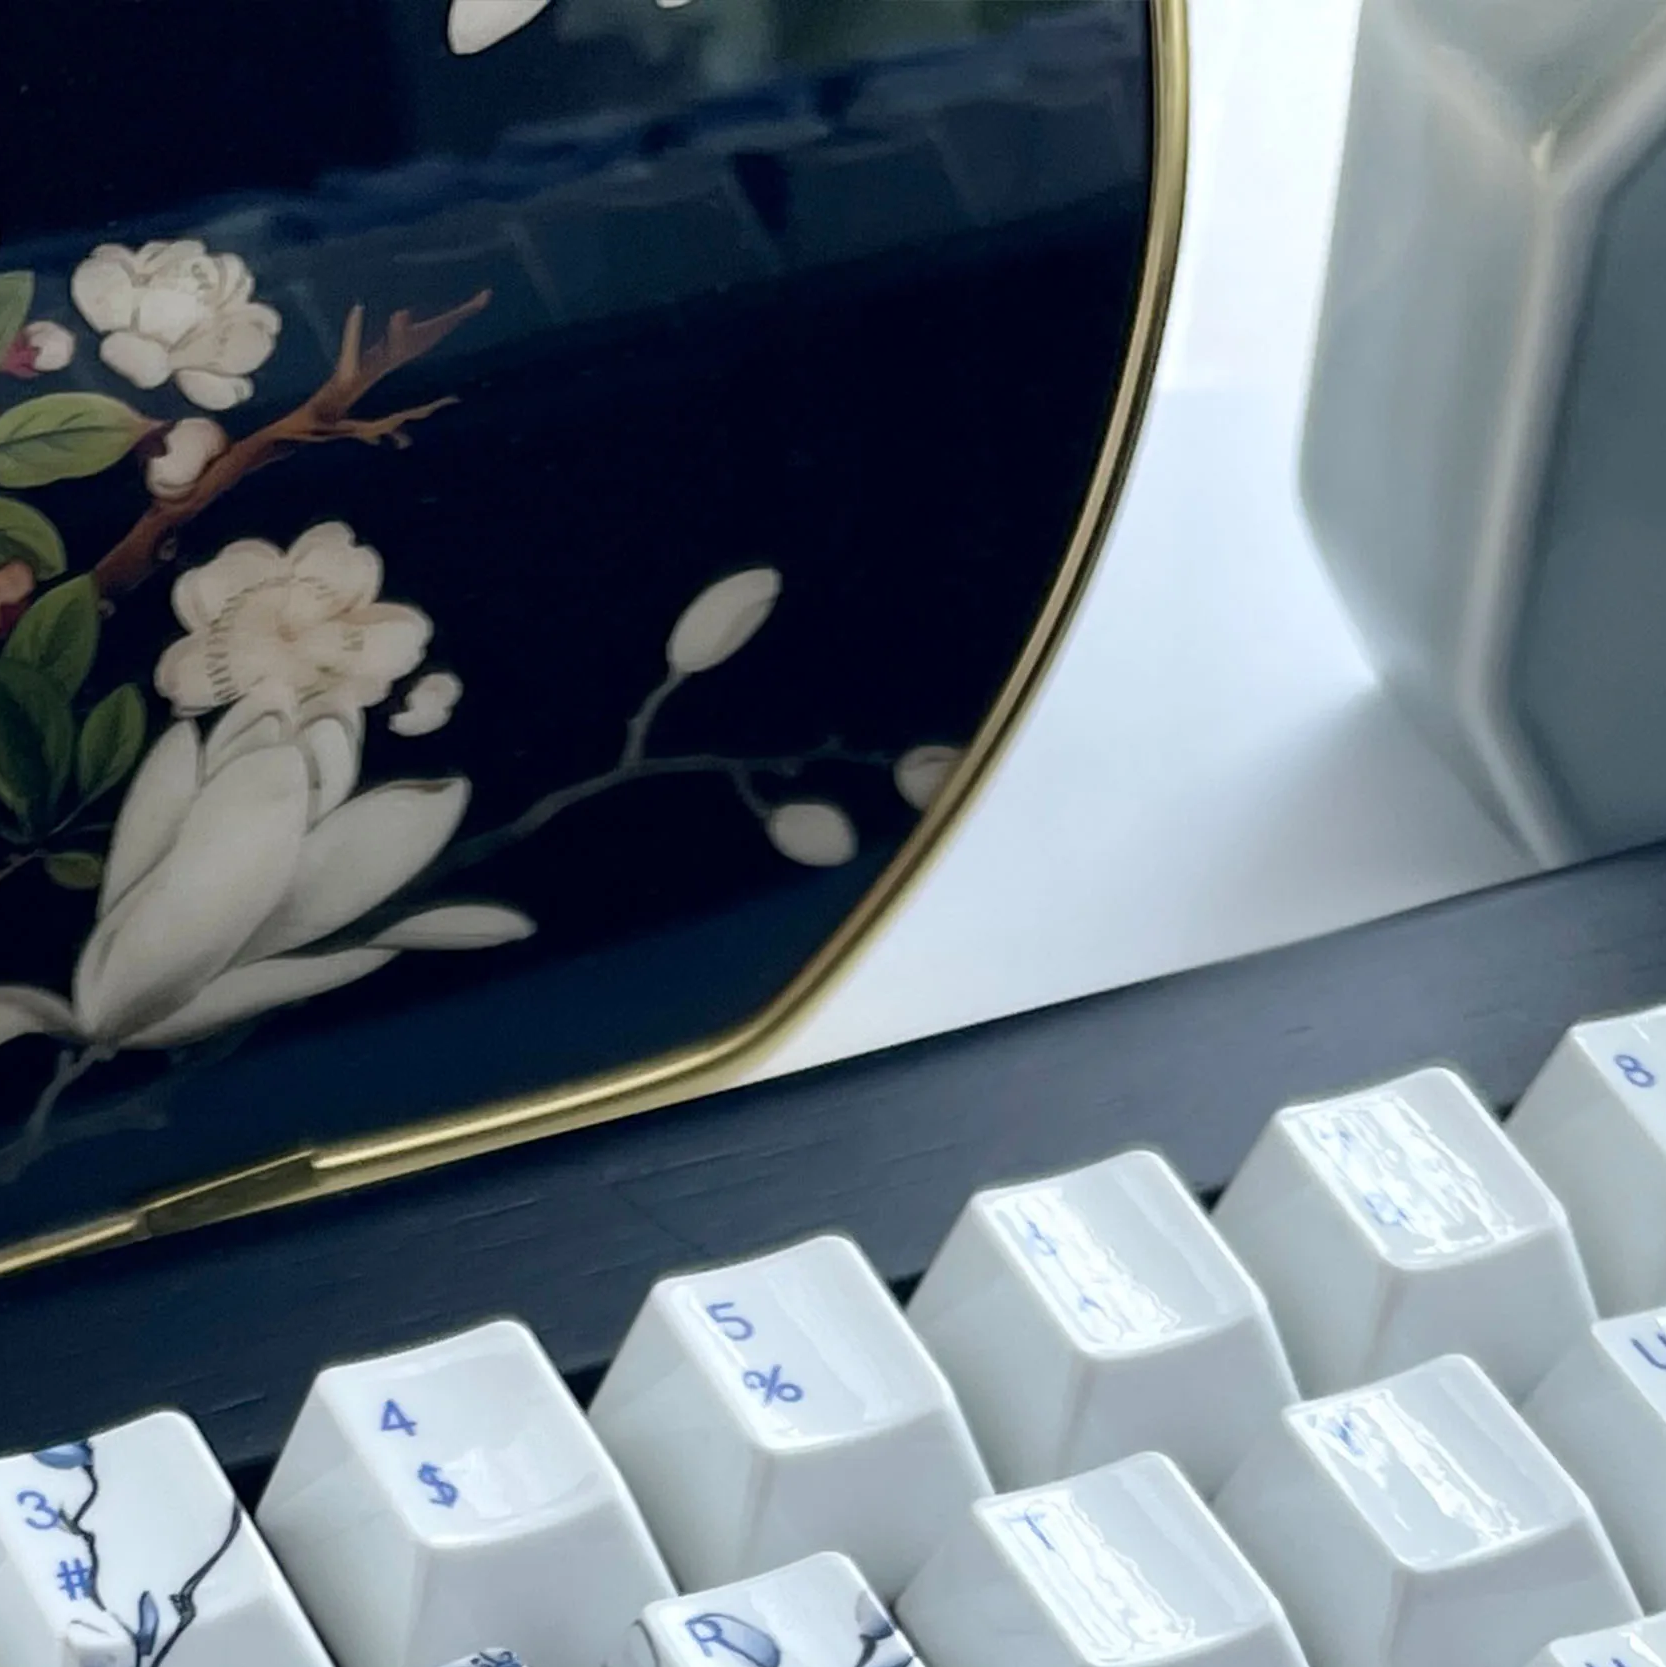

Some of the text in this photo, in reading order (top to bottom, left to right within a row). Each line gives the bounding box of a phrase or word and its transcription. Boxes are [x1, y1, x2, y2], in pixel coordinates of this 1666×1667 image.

[1615, 1053, 1656, 1088] 8
[707, 1301, 754, 1340] 5
[379, 1399, 418, 1438] 4
[16, 1488, 59, 1531] 3
[686, 1614, 729, 1655] R
